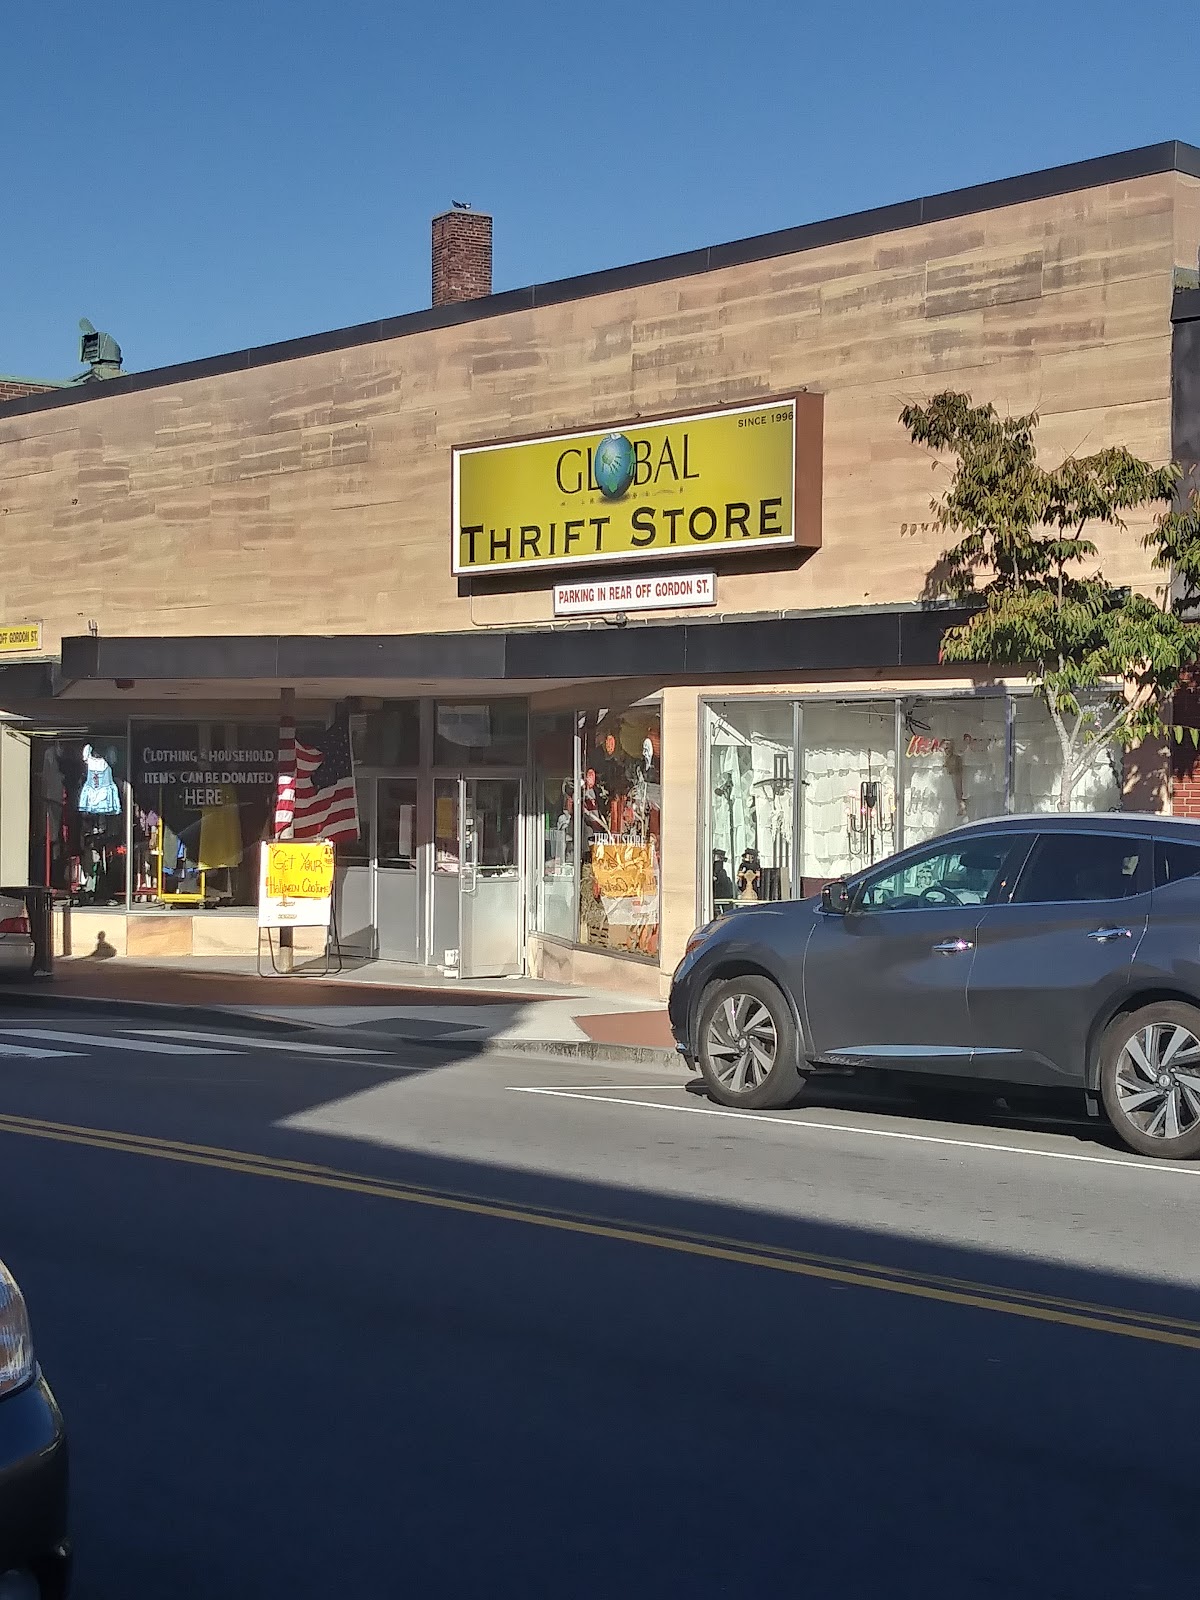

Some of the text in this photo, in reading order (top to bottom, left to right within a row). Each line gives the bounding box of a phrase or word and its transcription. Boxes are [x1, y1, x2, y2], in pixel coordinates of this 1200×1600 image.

[738, 411, 793, 428] SINCE 1996
[556, 433, 700, 498] GLOBAL
[461, 498, 782, 562] THRIFT STORE
[559, 579, 710, 604] PARKING IN REAR OFF GORDON ST.
[143, 747, 198, 763] CLOTHING
[208, 749, 275, 762] HOUSEHOLD
[144, 771, 274, 784] ITEMS CAN BE DONATED
